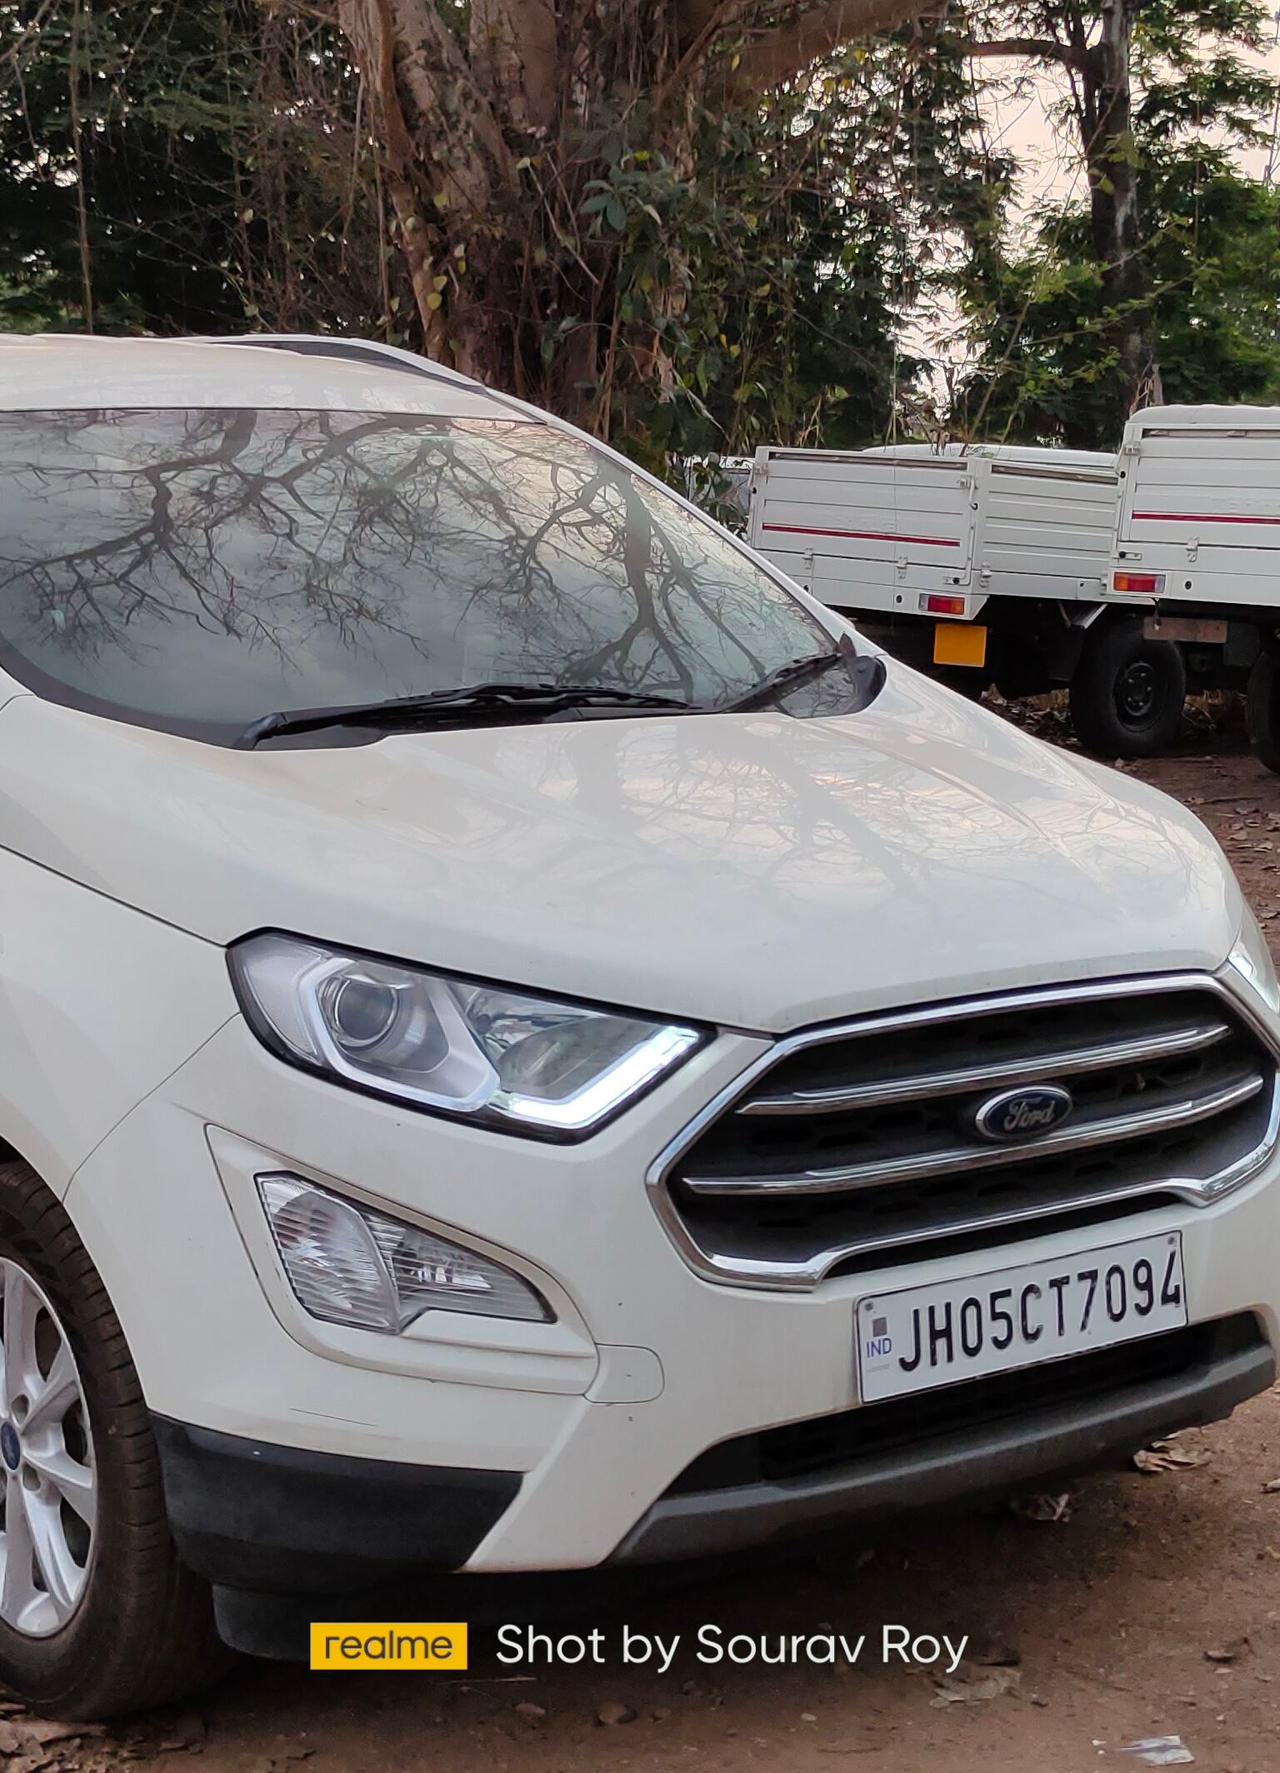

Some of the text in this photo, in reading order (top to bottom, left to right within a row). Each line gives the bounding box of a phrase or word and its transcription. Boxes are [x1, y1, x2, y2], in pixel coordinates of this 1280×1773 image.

[1003, 1096, 1056, 1132] Ford
[898, 1250, 1182, 1372] JH05CT7094
[866, 1337, 893, 1358] IND
